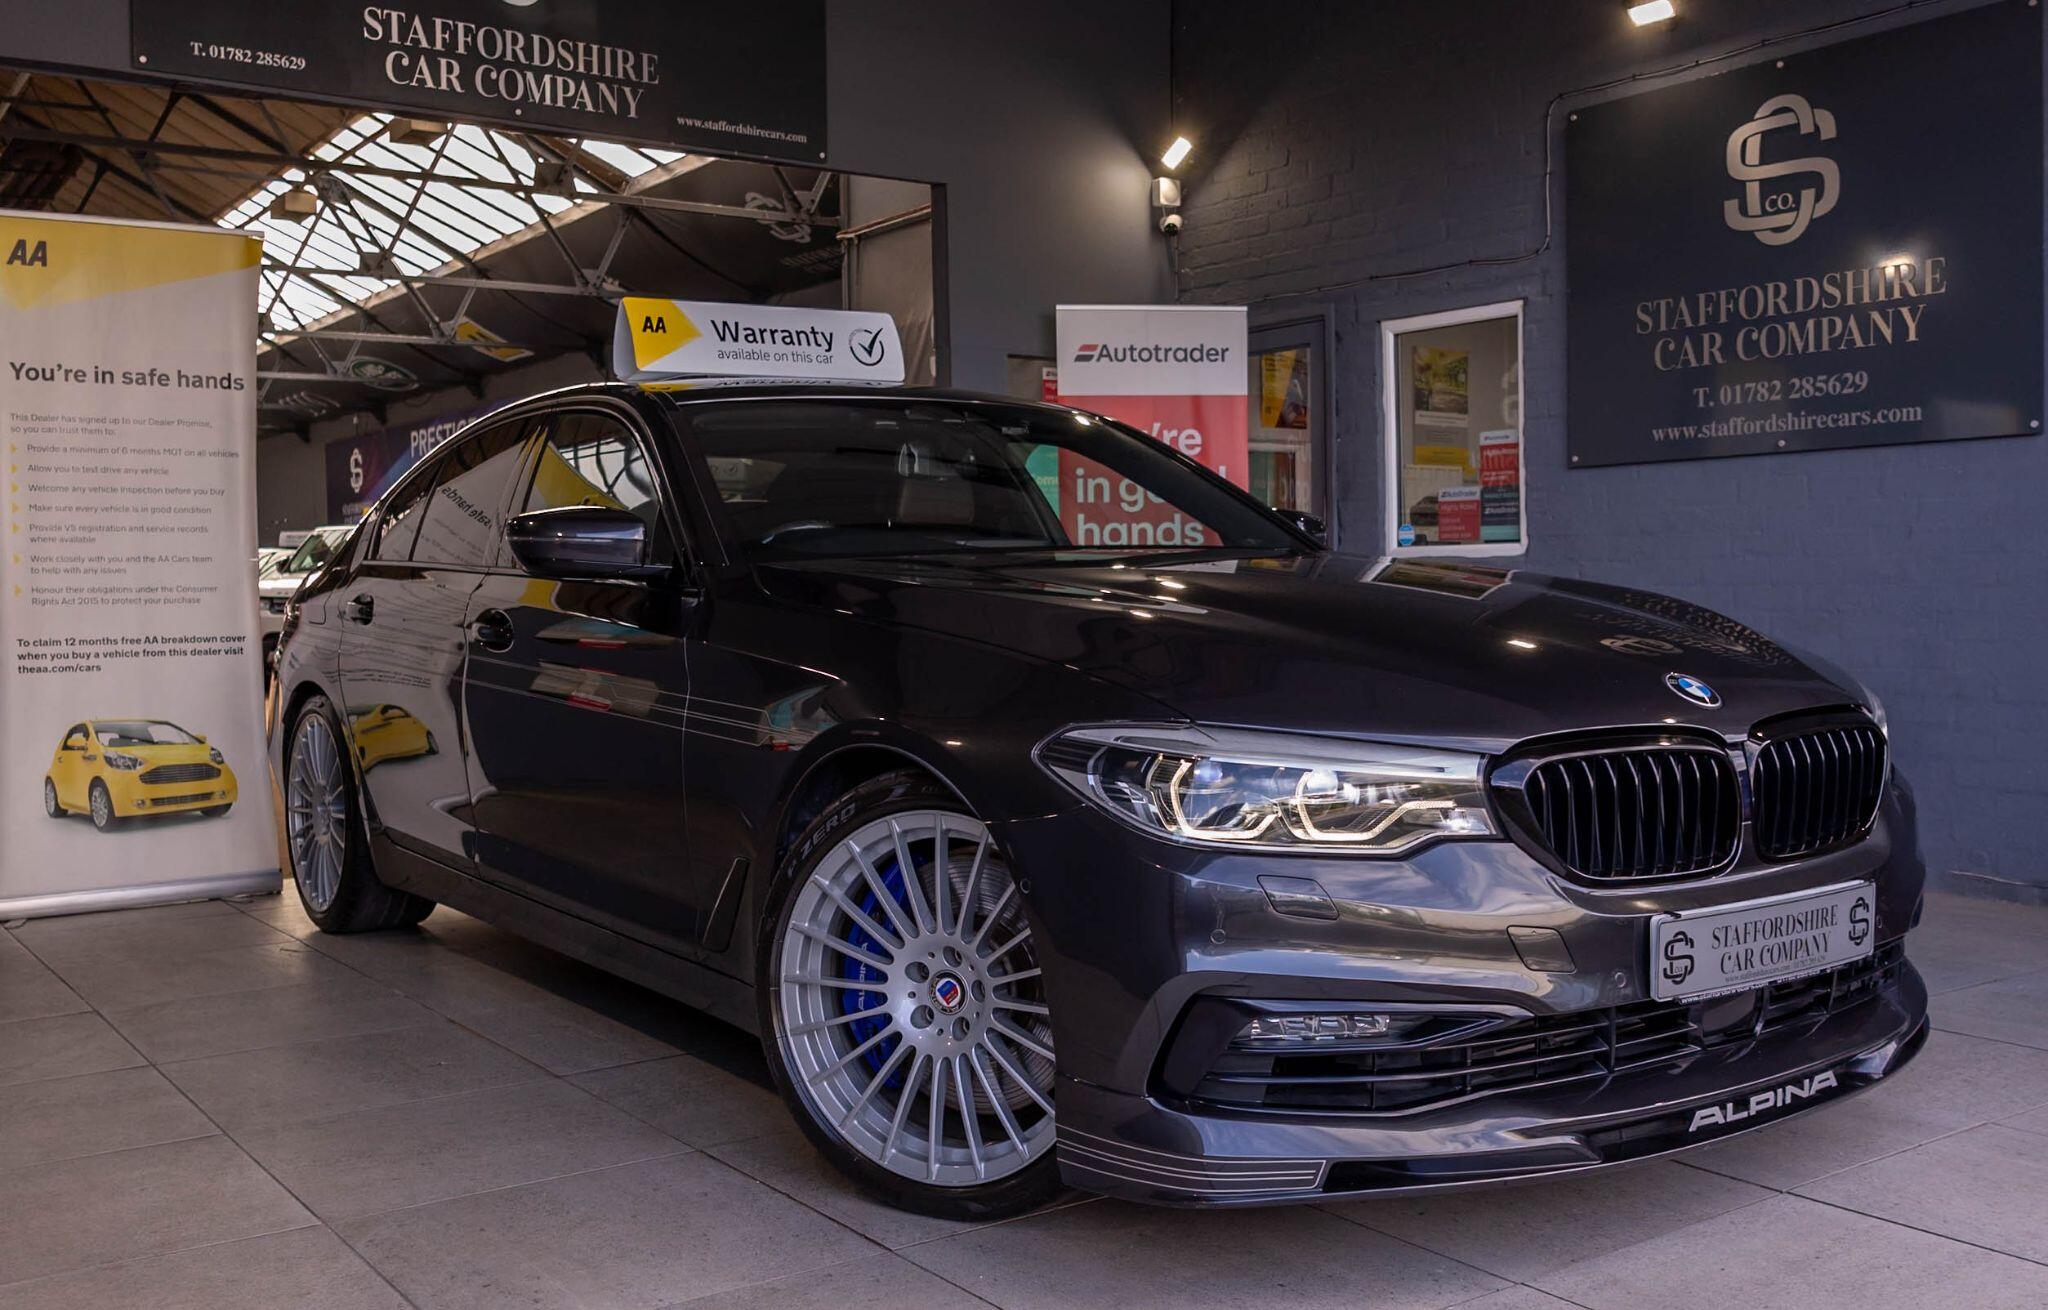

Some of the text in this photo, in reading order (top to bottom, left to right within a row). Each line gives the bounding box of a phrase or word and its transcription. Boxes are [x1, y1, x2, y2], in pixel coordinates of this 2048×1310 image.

[190, 41, 306, 70] T. 01782 285629
[363, 6, 660, 84] STAFFORDSHIRE
[386, 50, 645, 119] CAR COMPANY
[677, 116, 807, 143] www.staffordshirecars.com
[6, 238, 48, 268] AA
[1636, 257, 1948, 335] STAFFORDSHIRE
[642, 316, 667, 334] AA
[710, 319, 834, 352] Warranty
[1655, 304, 1927, 371] CAR COMPANY
[717, 350, 833, 364] available on this car
[1096, 343, 1230, 363] Autotrader
[10, 361, 244, 391] You're in safe hands
[1693, 371, 1868, 408] T. 01782 285629
[1652, 404, 1923, 442] www.staffordshirecars.com
[28, 464, 51, 473] Allow
[54, 466, 70, 475] you
[100, 466, 121, 474] drive
[122, 468, 138, 476] any
[141, 467, 170, 475] vehicle
[28, 484, 226, 497] Welcome any vehicle inspection before you buy
[1076, 467, 1110, 504] in
[29, 503, 53, 512] Make
[54, 504, 73, 512] sure
[75, 505, 98, 515] every
[100, 505, 130, 513] vehicle
[132, 505, 139, 513] is
[151, 506, 172, 516] good
[173, 506, 213, 514] condition
[29, 523, 63, 532] Provide
[78, 524, 126, 534] registration
[128, 525, 144, 533] and
[29, 536, 96, 544] where available
[1077, 513, 1205, 546] hands
[30, 555, 213, 565] Work closely with you and the AA Cars team
[30, 567, 126, 577] to help with any issues
[31, 584, 219, 596] Honour their obligations under the Consumer
[31, 596, 202, 607] Rights Act 2015 to protect your purchase
[17, 634, 246, 648] To claim 12 months free AA breakdown cover
[17, 646, 244, 663] when you buy a vehicle from this dealer visit
[17, 664, 102, 674] theaa.com/cars
[801, 802, 856, 860] ZERO
[1711, 904, 1839, 950] STAFFORDSHIRE
[1720, 948, 1756, 975] CAR
[1760, 931, 1832, 967] COMPANY
[1688, 1070, 1838, 1132] ALPINA
